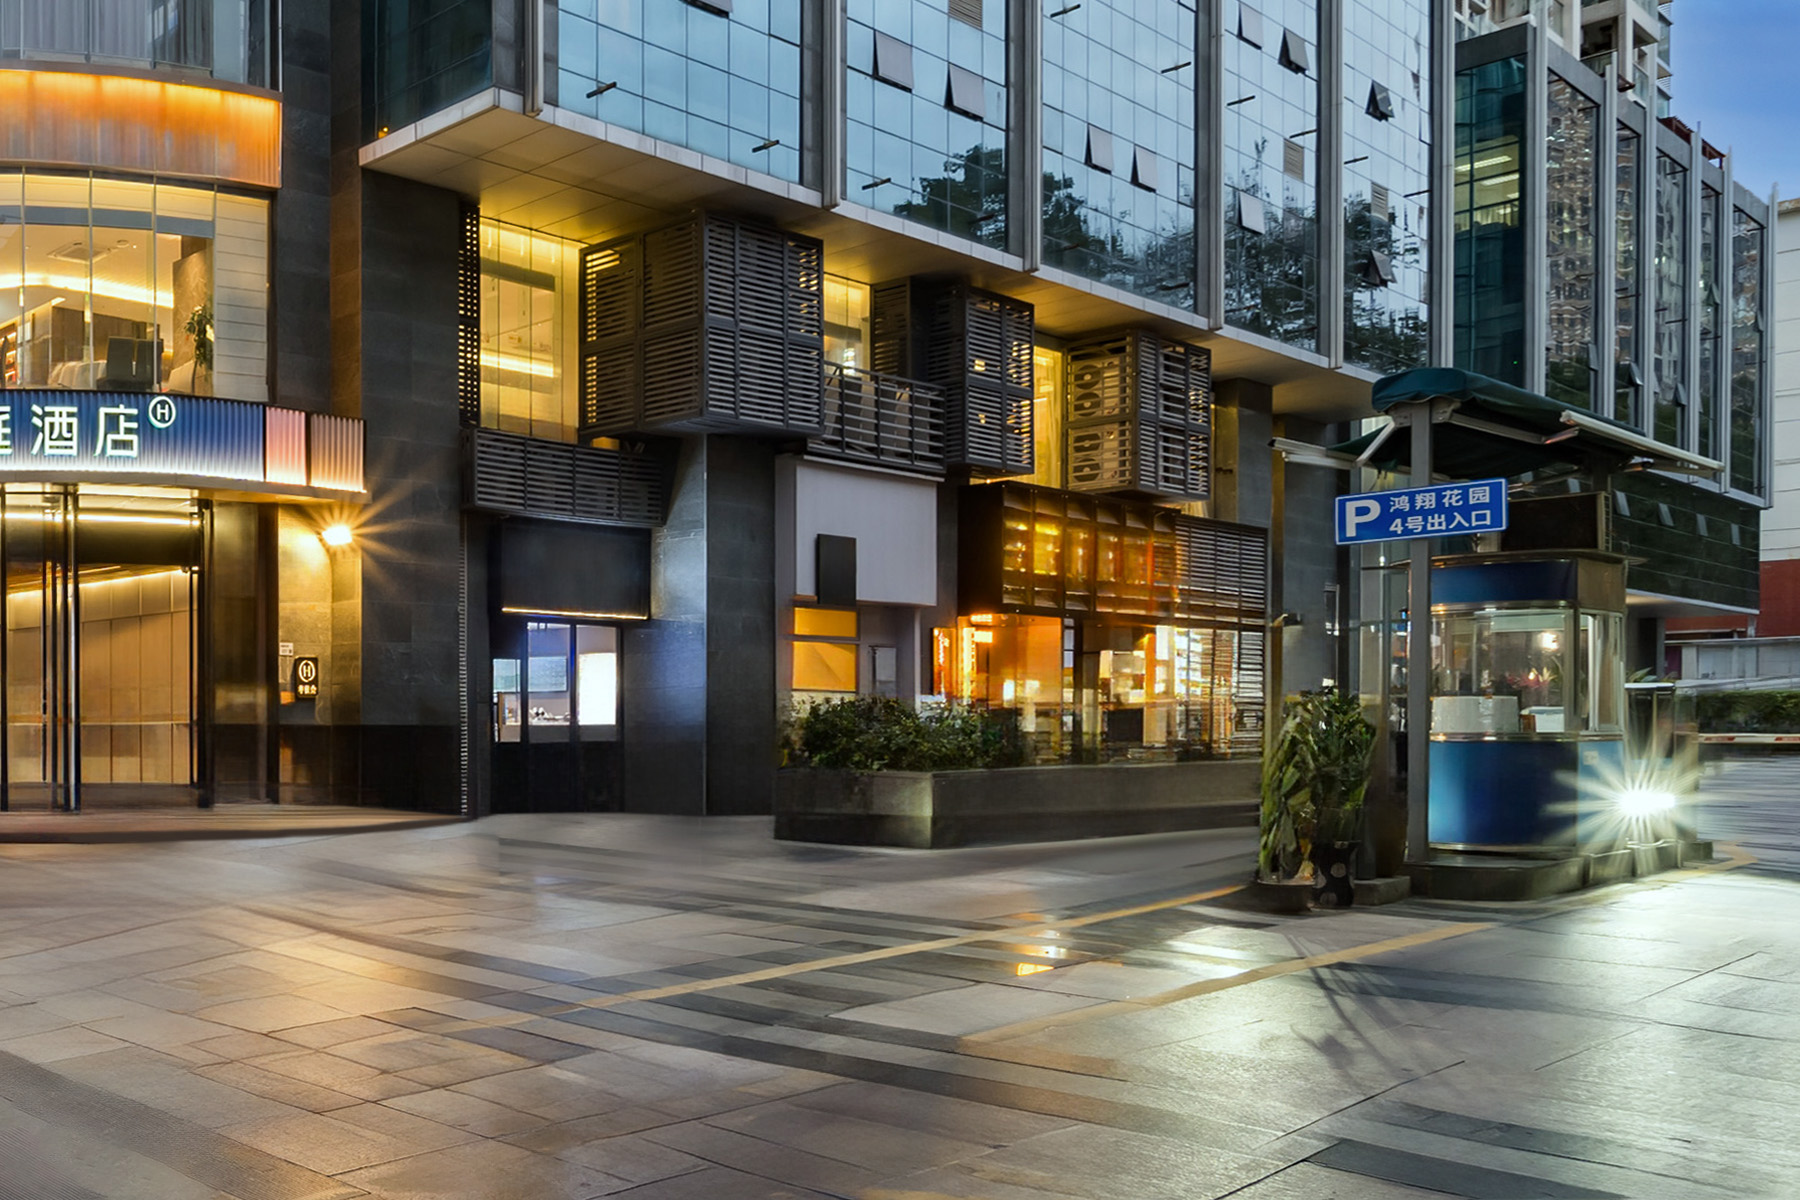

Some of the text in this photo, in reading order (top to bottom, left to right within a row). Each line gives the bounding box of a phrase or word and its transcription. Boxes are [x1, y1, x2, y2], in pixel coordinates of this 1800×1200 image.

[1389, 486, 1490, 513] 鸿翔花园
[1345, 499, 1381, 537] P
[1389, 510, 1491, 534] 4号出入口
